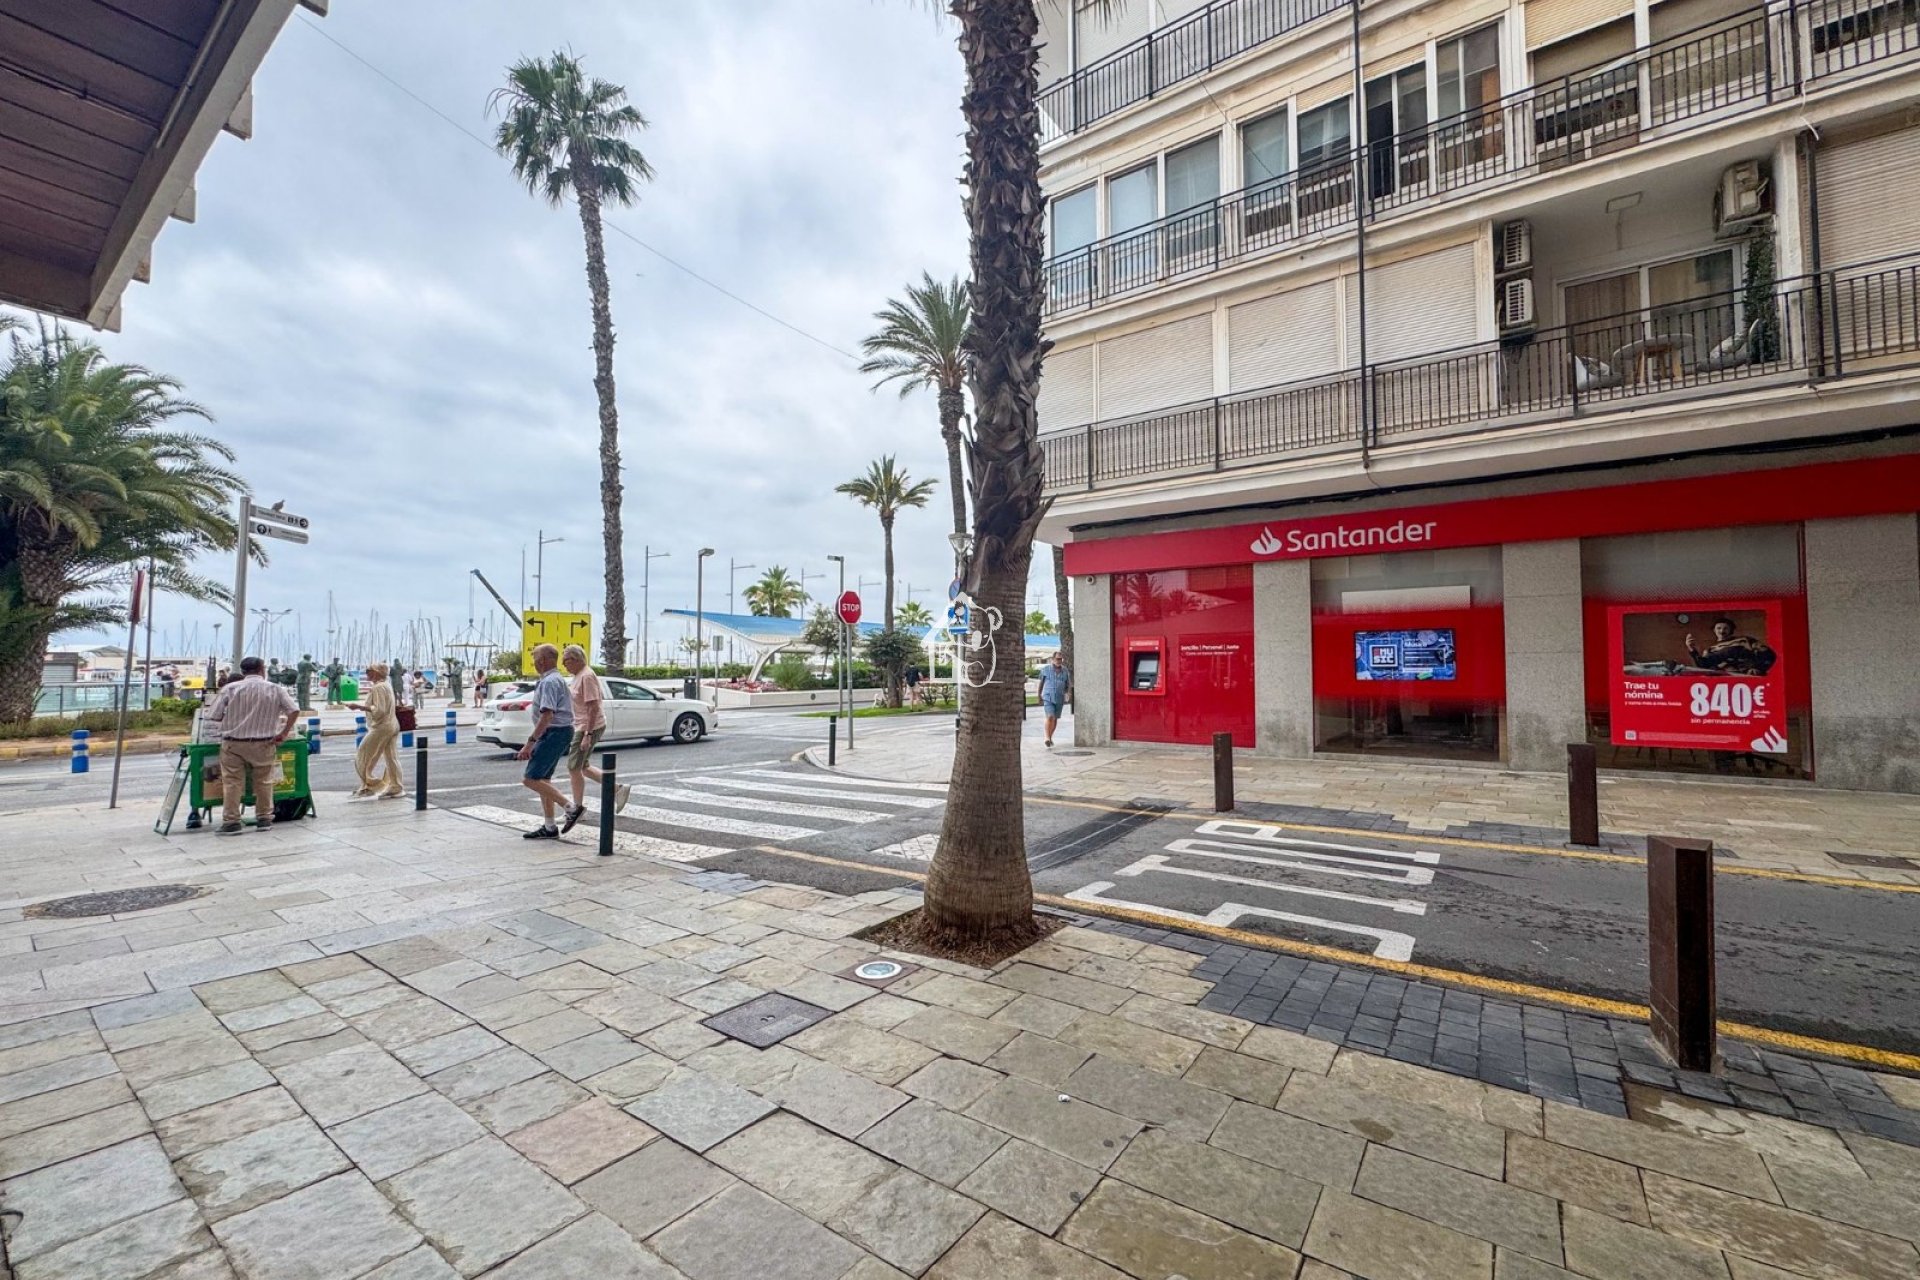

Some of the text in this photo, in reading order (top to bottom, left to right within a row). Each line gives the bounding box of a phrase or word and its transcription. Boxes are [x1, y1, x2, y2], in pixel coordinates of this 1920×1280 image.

[1287, 520, 1437, 552] Santander
[842, 603, 860, 612] STOP
[1624, 682, 1660, 690] Trae tu
[1624, 691, 1664, 699] nómina
